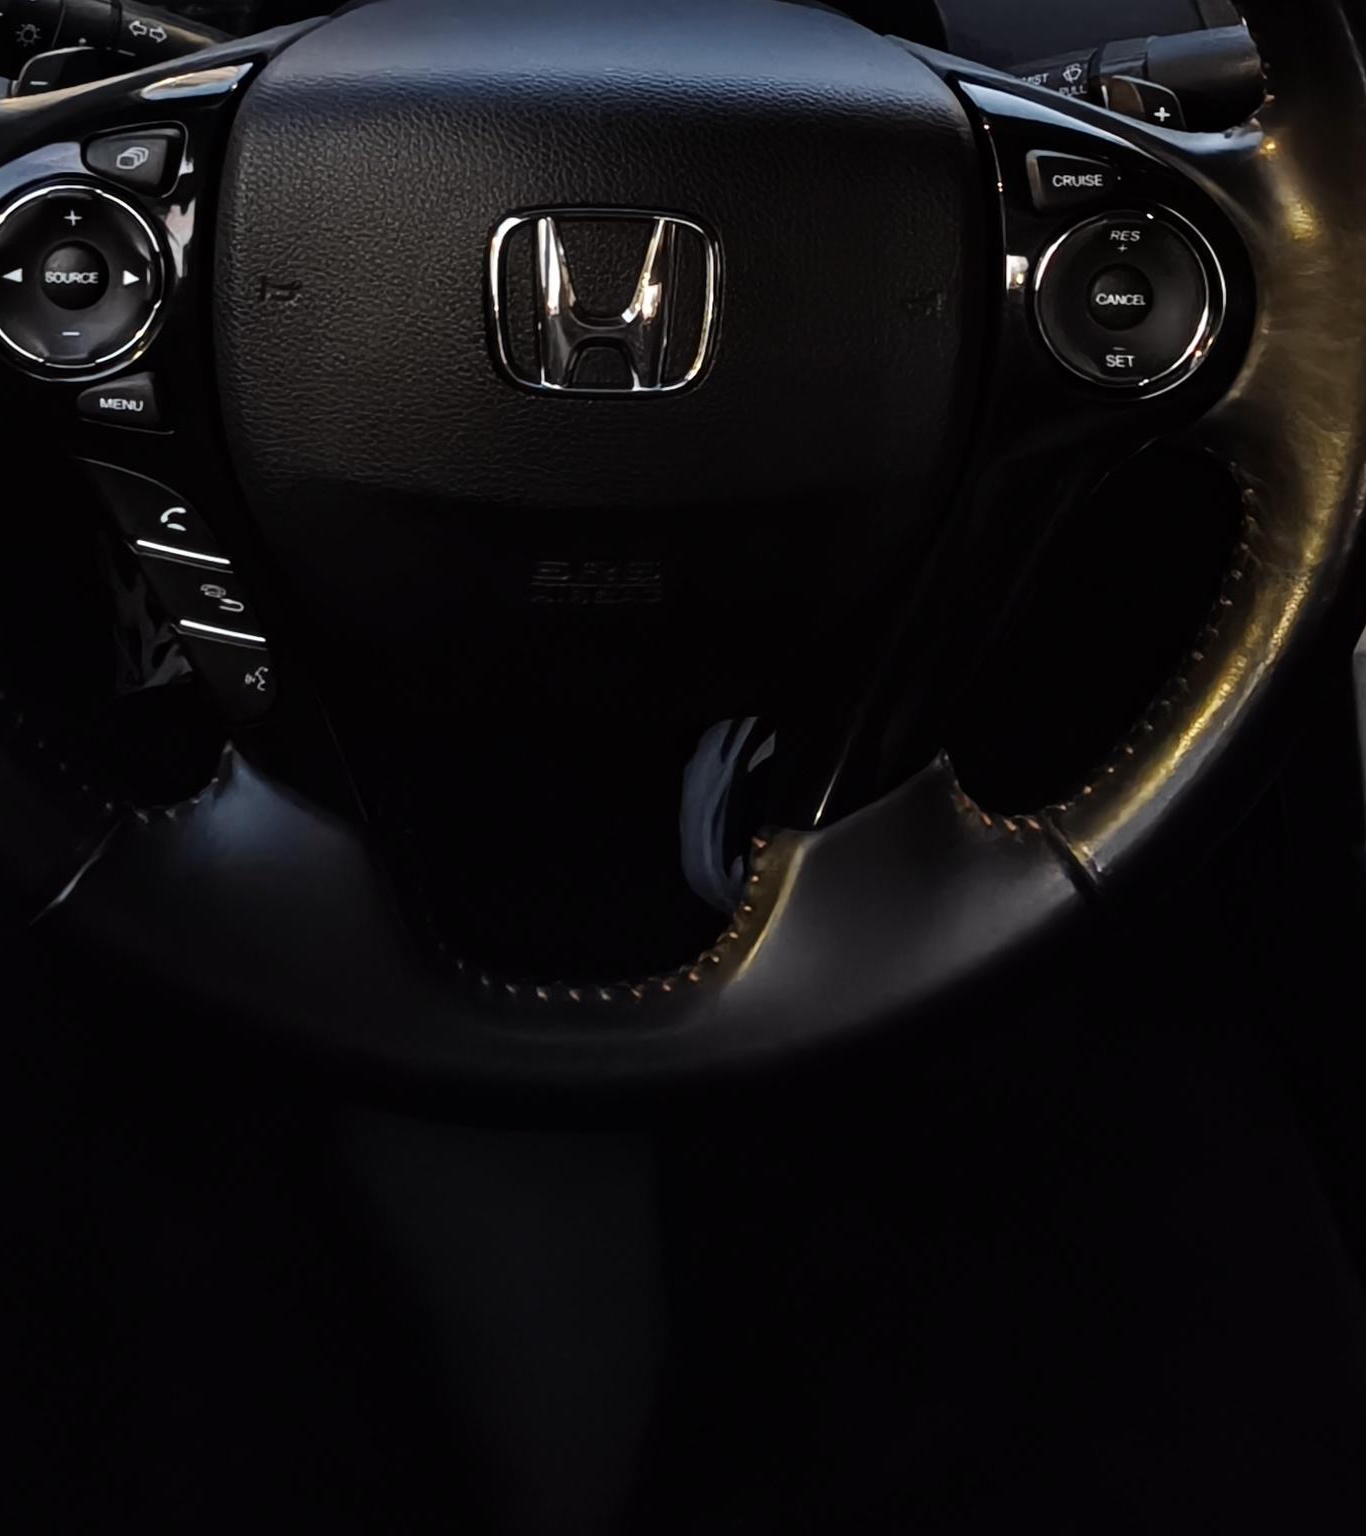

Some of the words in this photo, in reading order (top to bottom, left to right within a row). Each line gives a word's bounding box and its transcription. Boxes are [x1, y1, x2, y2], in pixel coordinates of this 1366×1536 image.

[1052, 174, 1104, 187] CRUISE
[1110, 230, 1141, 242] RES
[44, 270, 99, 284] SOURCE
[1095, 292, 1146, 306] CANCEL
[1105, 354, 1135, 368] SET
[99, 397, 144, 412] MENU
